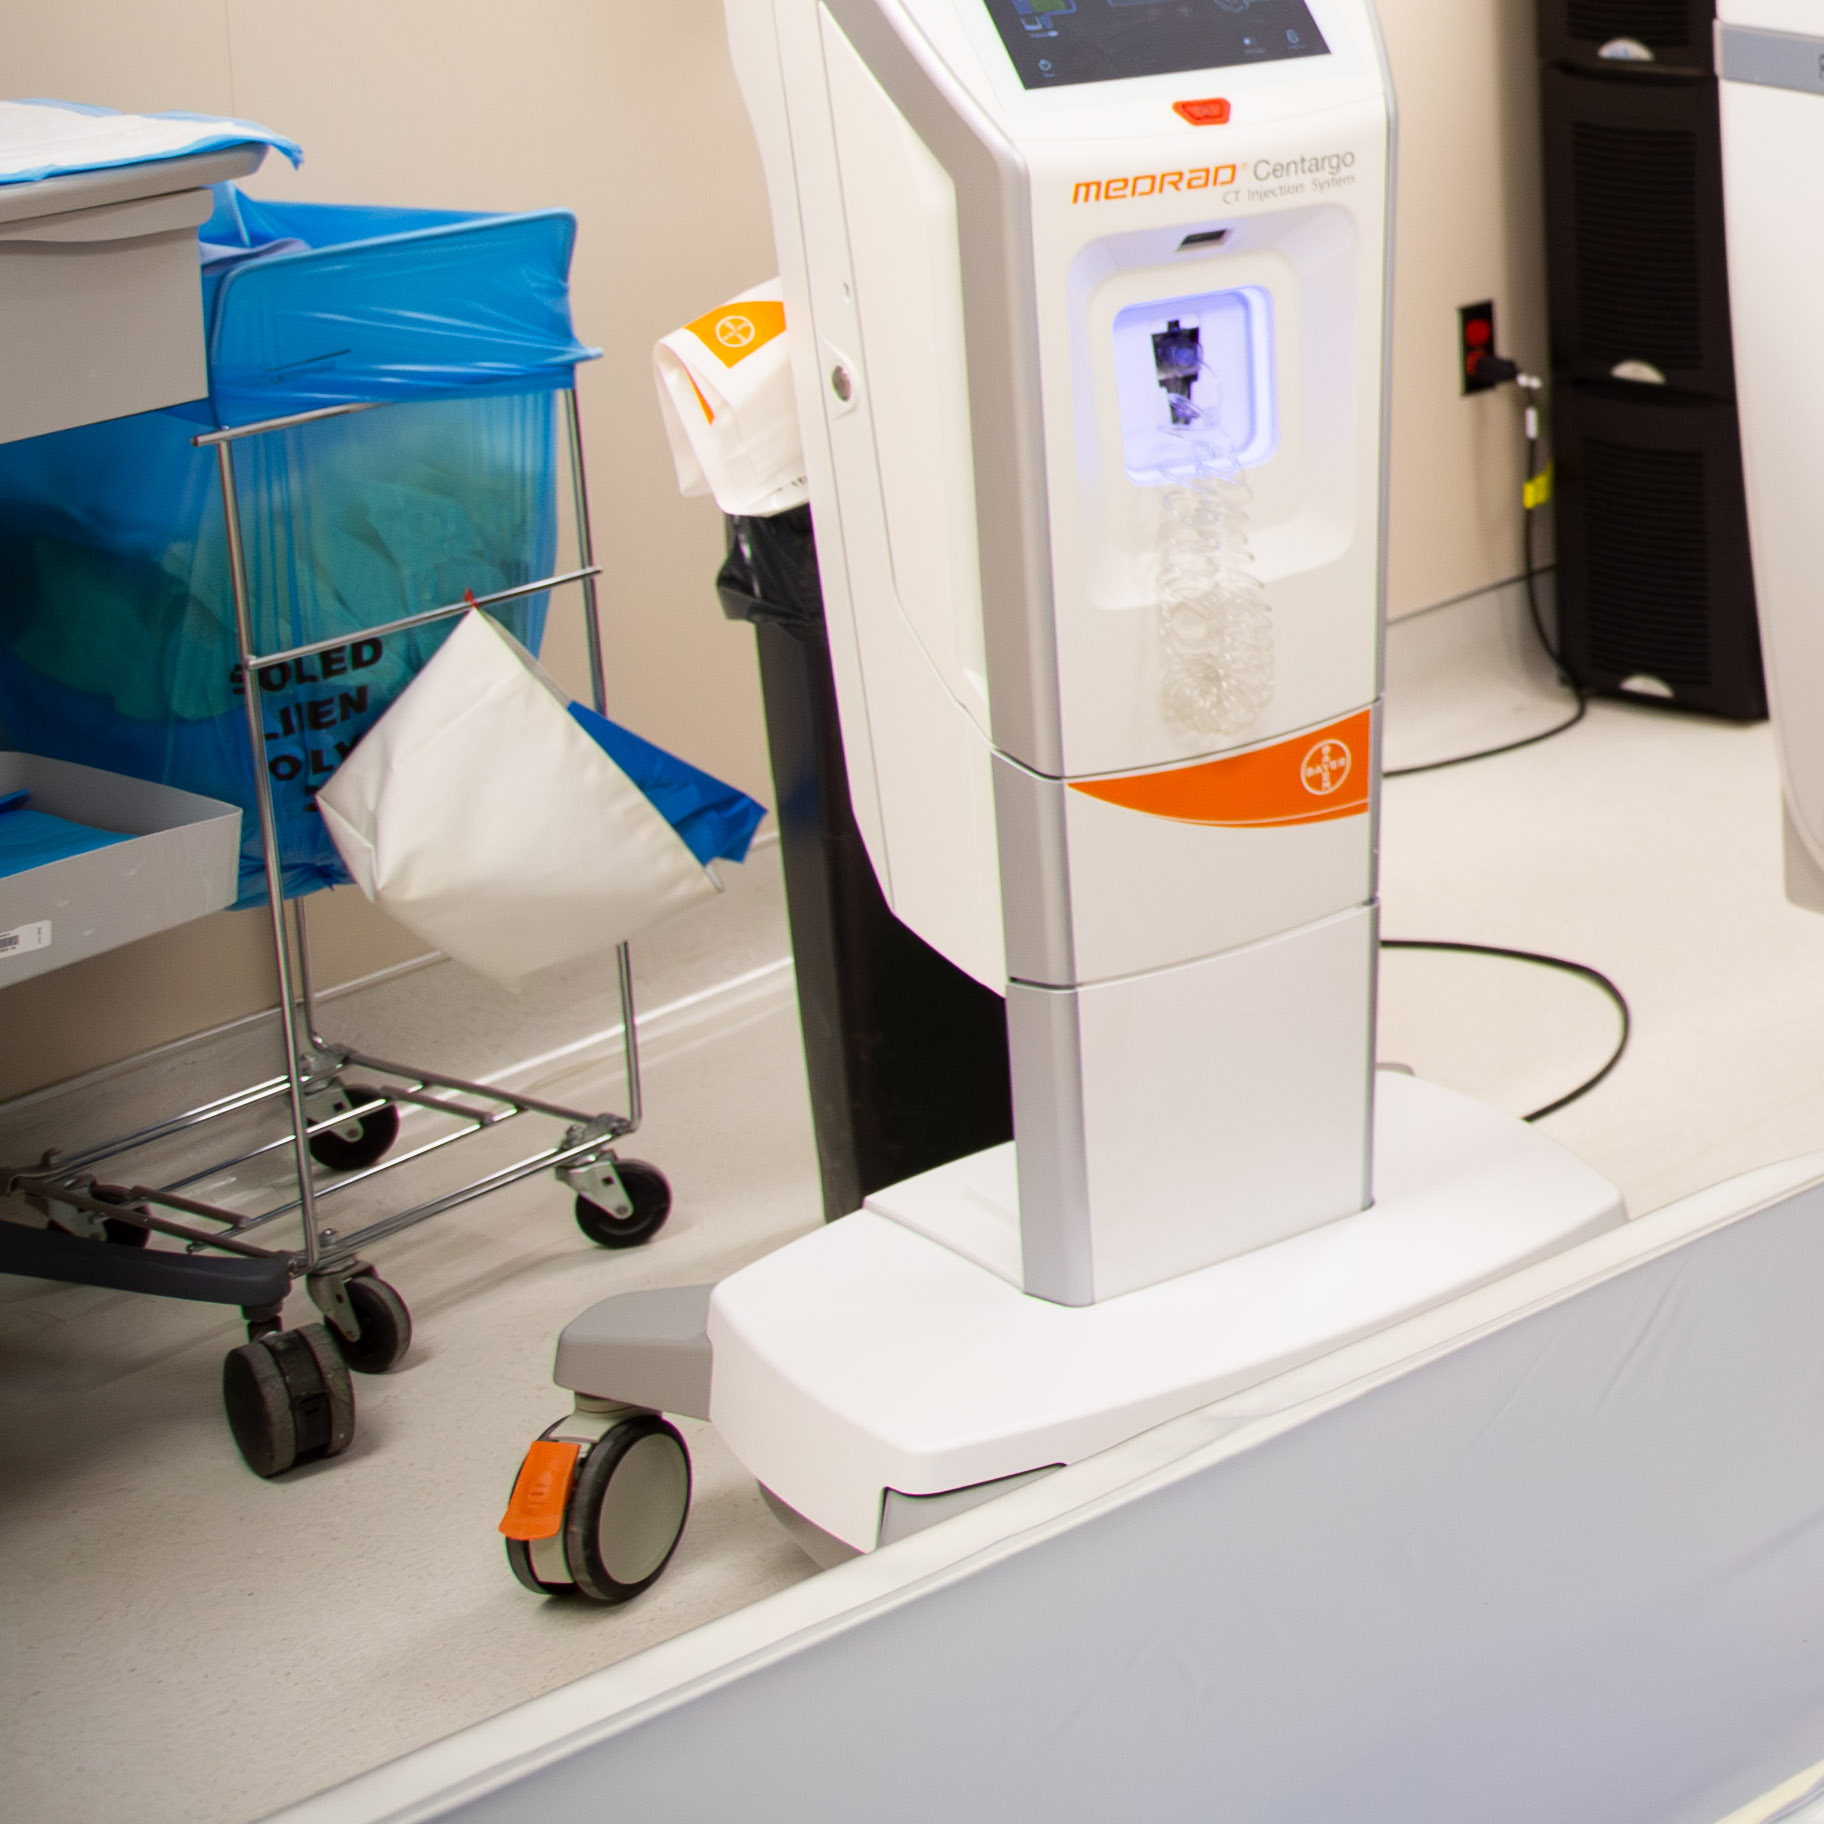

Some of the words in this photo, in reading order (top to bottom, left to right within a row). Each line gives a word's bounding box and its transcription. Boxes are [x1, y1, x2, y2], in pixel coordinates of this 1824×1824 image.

[1253, 150, 1355, 181] Centargo
[1222, 189, 1242, 205] CT
[1247, 182, 1305, 203] Injection
[1311, 174, 1356, 193] System
